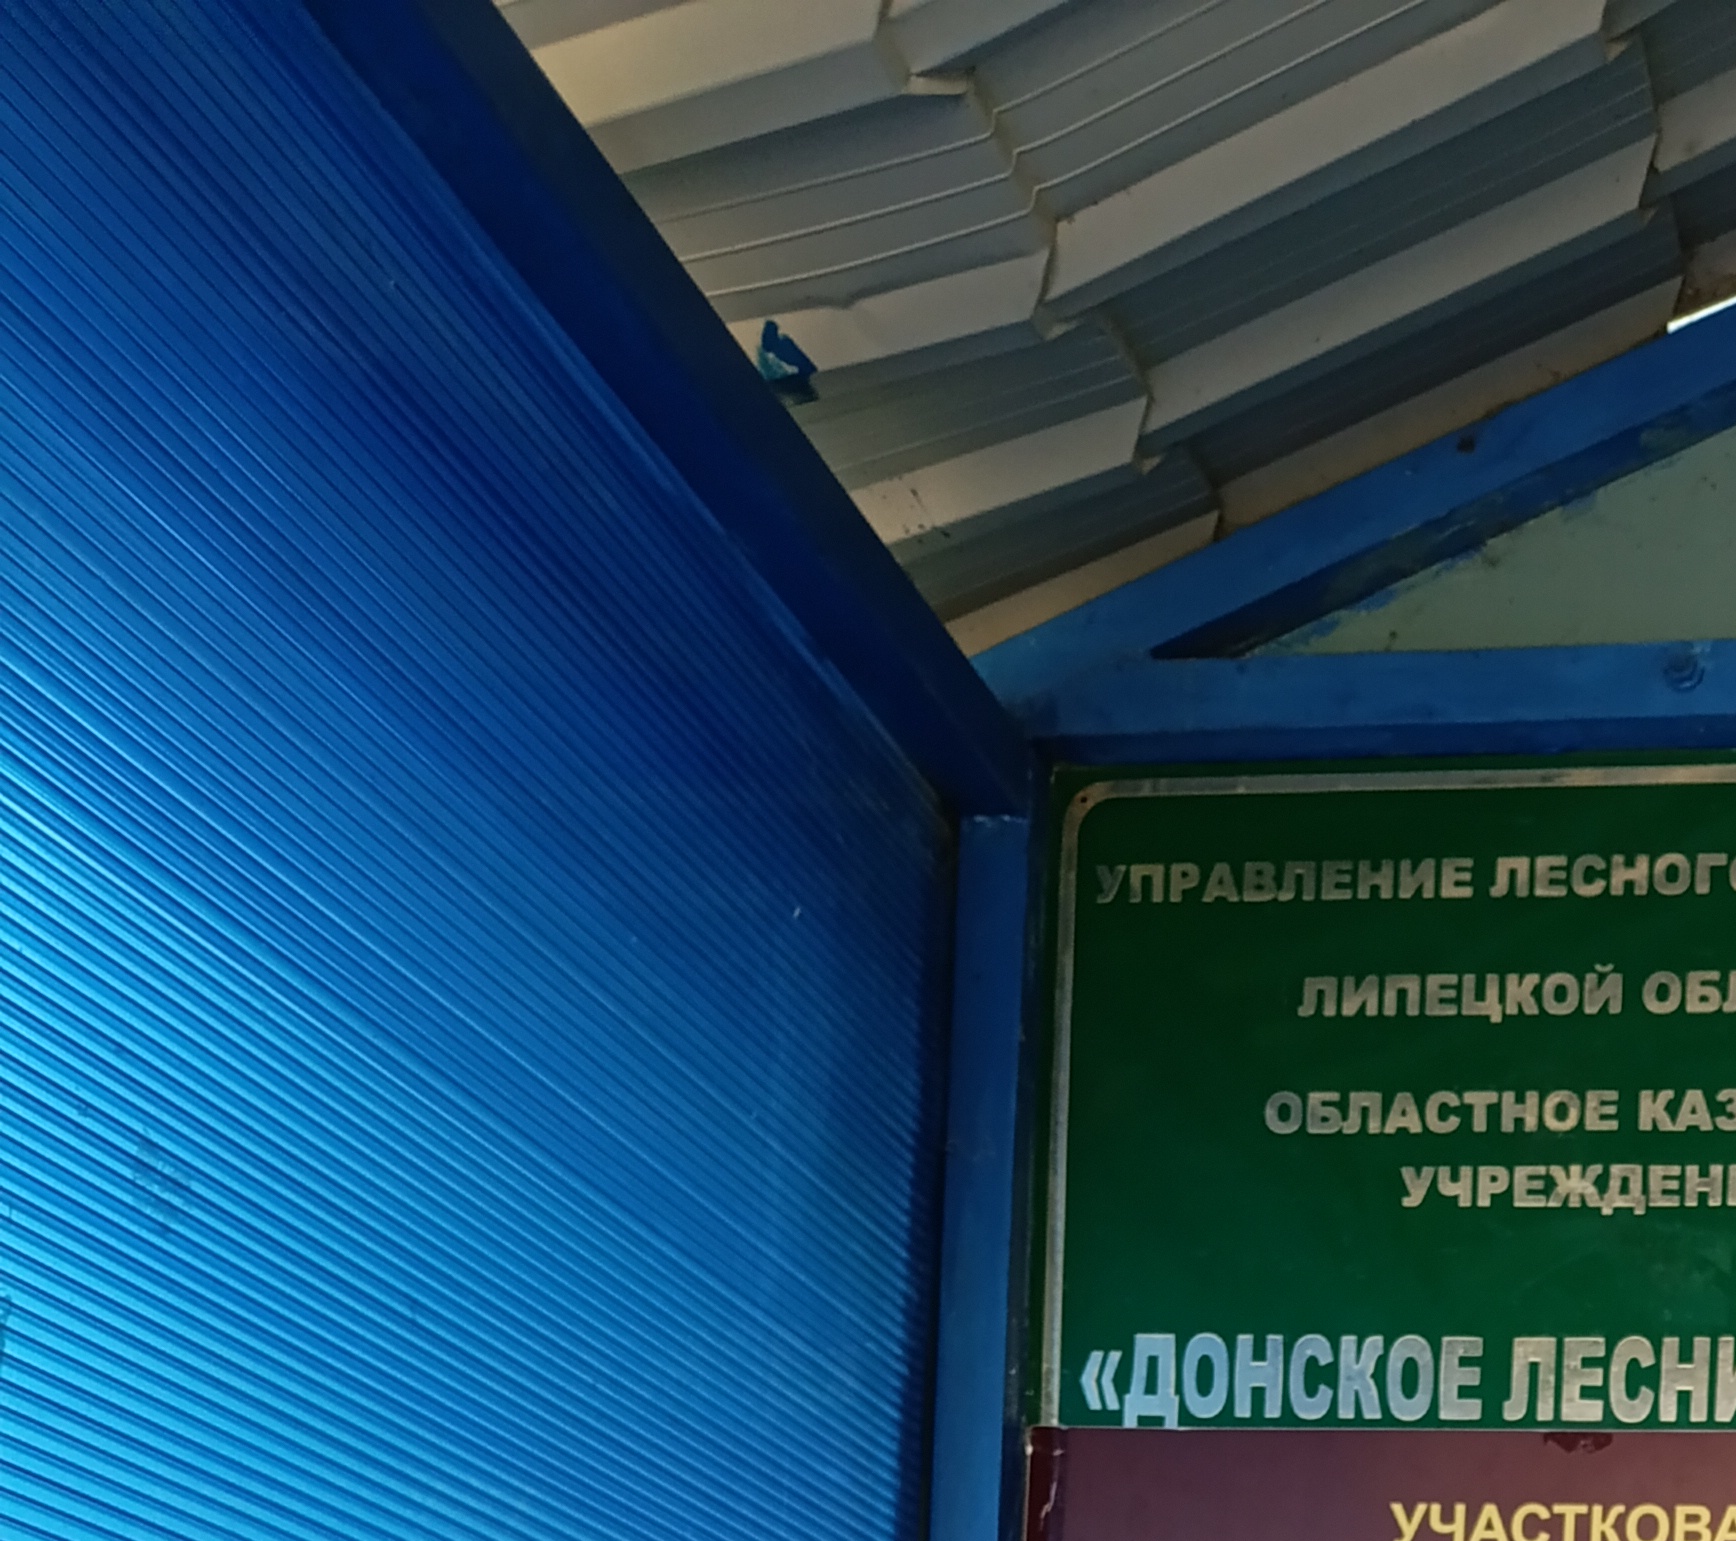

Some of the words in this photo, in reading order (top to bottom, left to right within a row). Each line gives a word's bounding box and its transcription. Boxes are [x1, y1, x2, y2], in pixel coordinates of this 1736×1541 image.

[1096, 857, 1474, 905] УПРАВЛЕНИЕ
[1297, 963, 1623, 1024] ЛИПЕЦКОЙ
[1264, 1089, 1619, 1136] ОБЛАСТНОЕ
[1079, 1332, 1484, 1427] «ДОНСКОЕ
